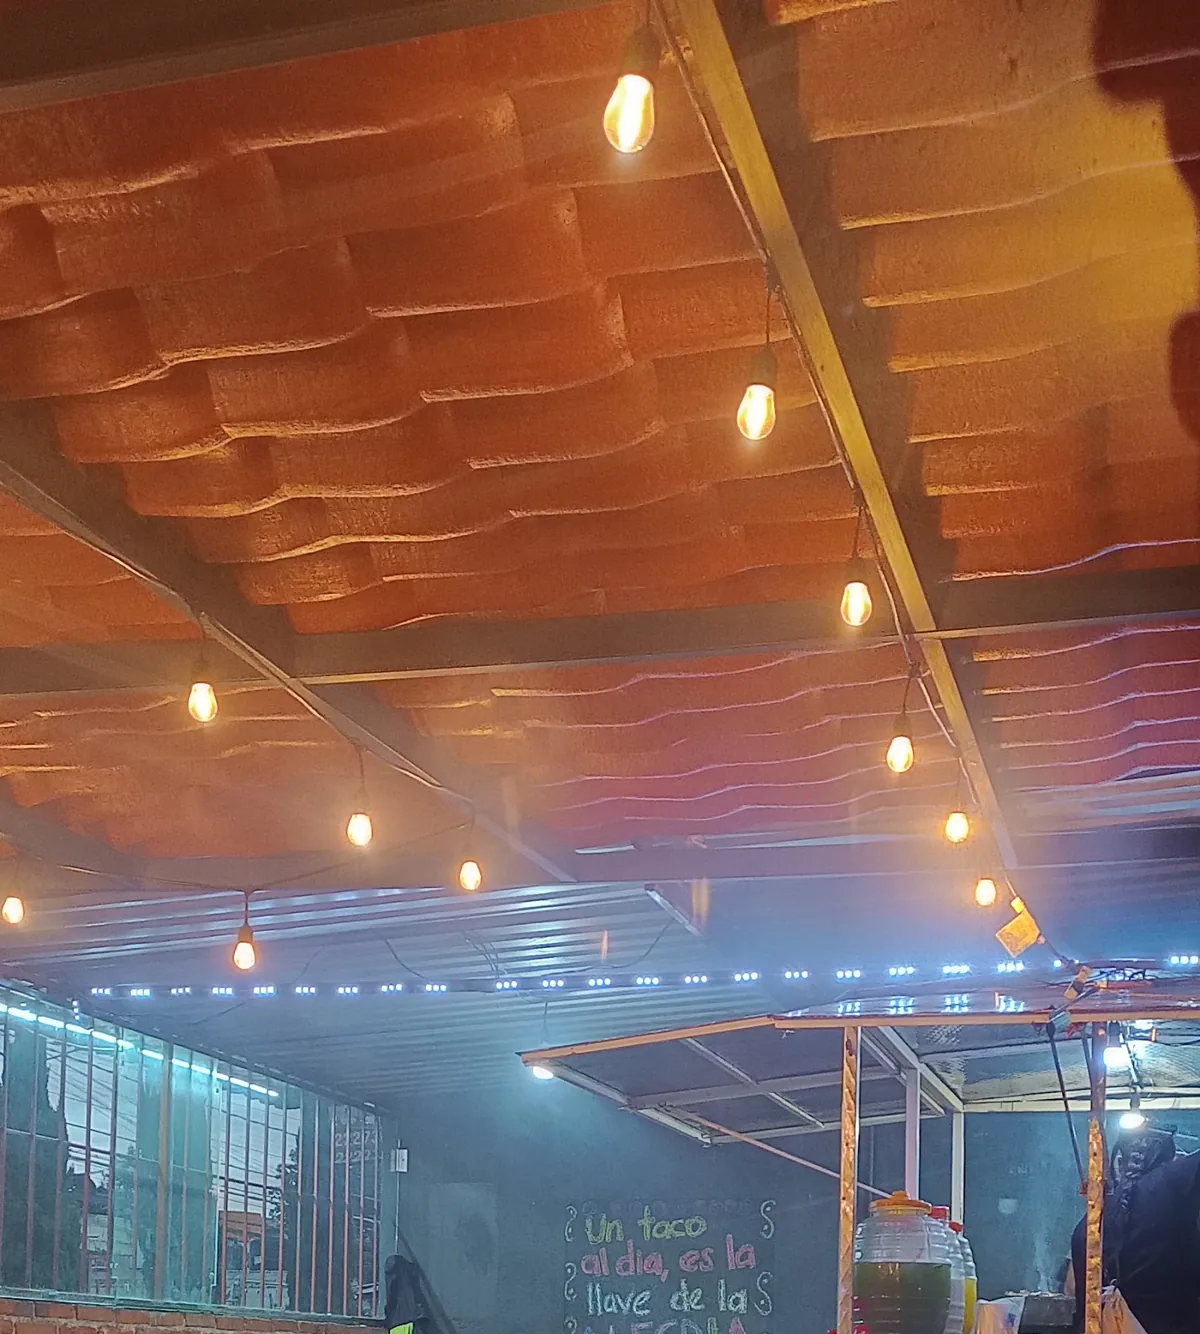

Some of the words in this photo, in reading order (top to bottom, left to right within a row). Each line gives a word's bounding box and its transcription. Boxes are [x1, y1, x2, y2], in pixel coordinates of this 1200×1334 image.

[585, 1213, 624, 1245] Un
[638, 1205, 707, 1241] taco
[581, 1247, 610, 1276] al
[679, 1248, 714, 1272] es
[726, 1234, 756, 1270] la
[586, 1280, 651, 1316] llave
[669, 1278, 705, 1312] de
[717, 1278, 748, 1314] la
